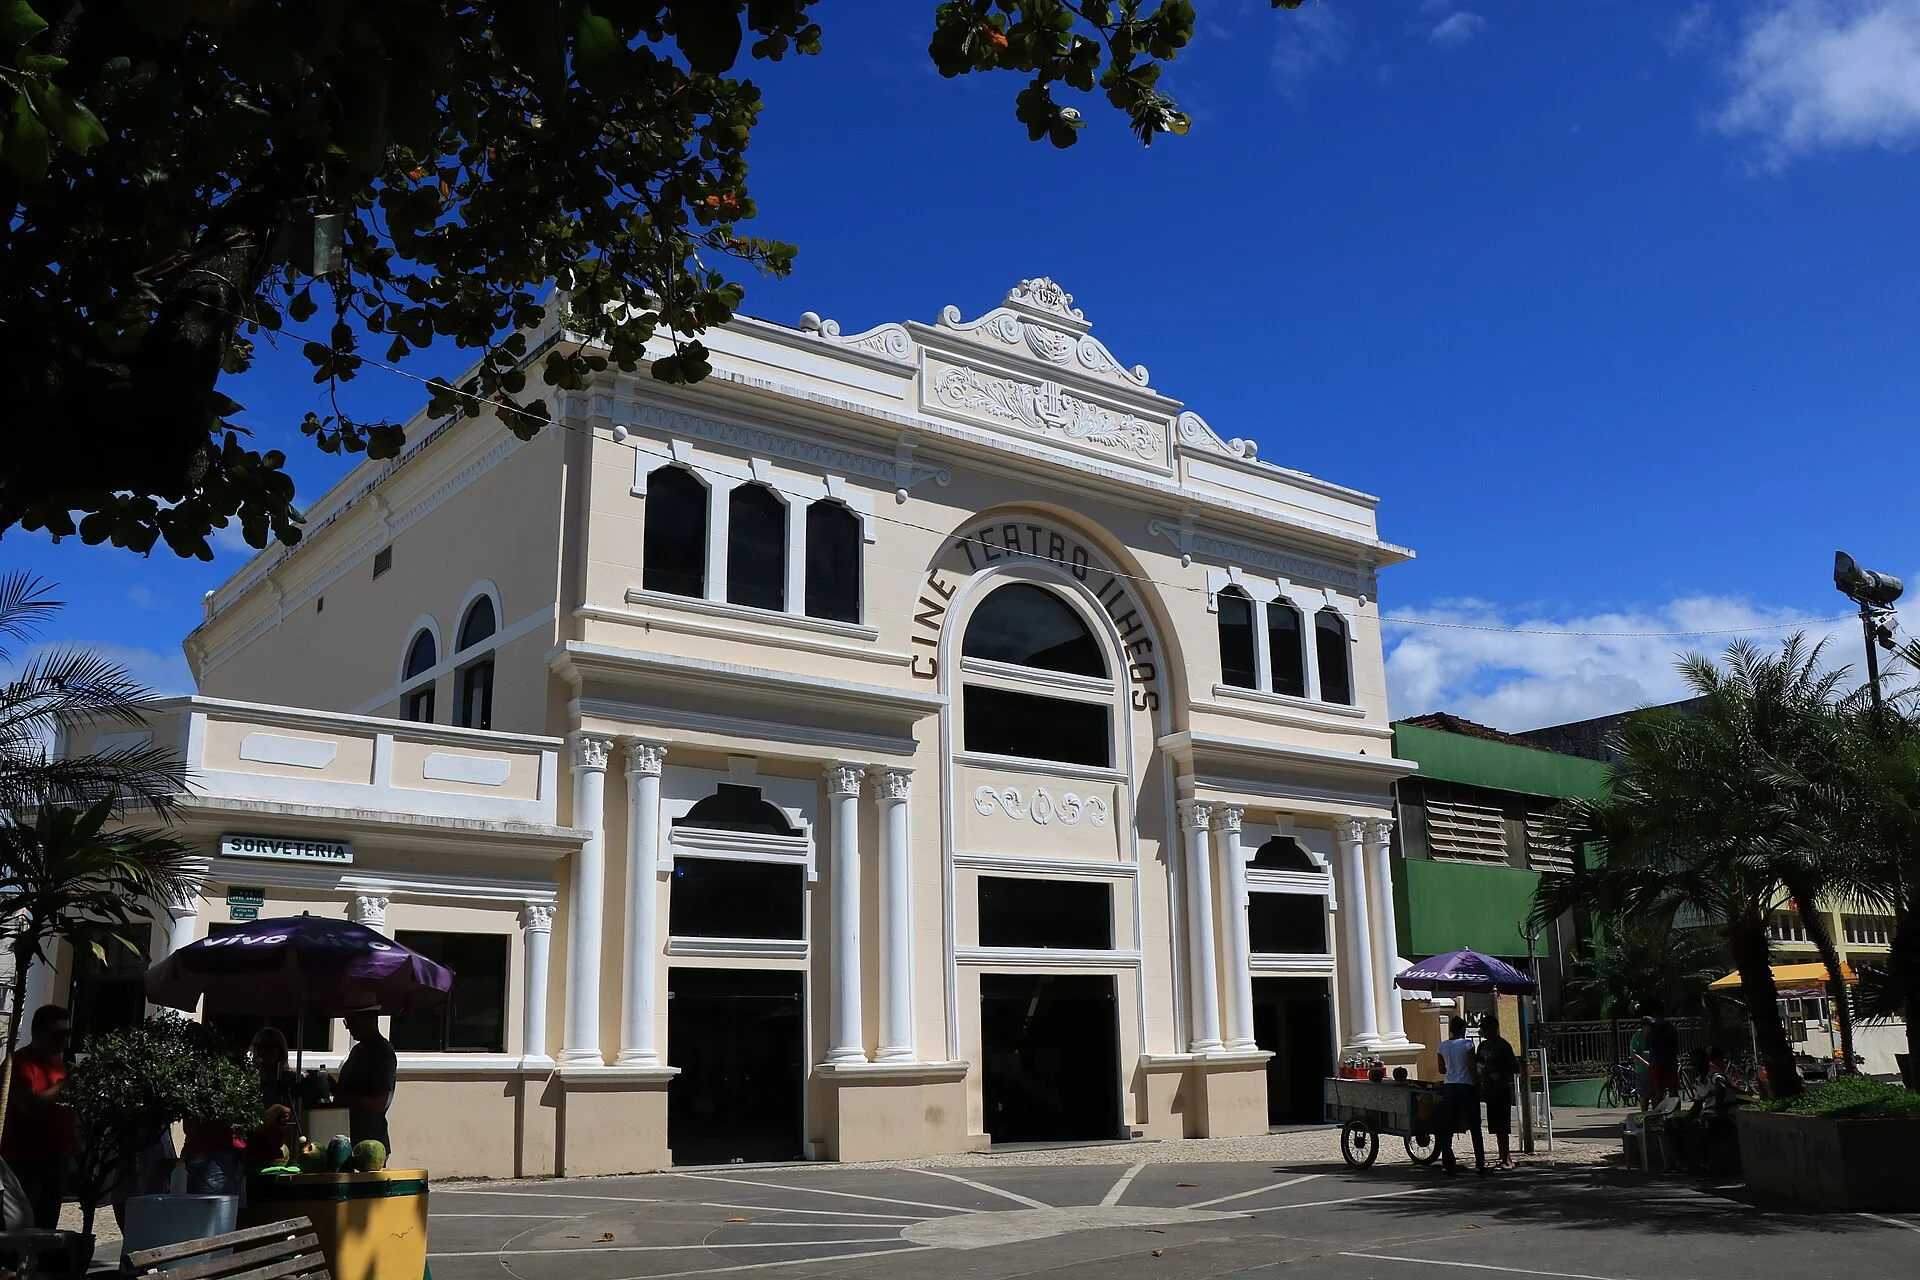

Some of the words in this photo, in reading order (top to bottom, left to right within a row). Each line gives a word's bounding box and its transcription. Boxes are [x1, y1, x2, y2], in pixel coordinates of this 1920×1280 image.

[911, 568, 957, 680] CINE
[955, 524, 1089, 581] TEATRO
[231, 838, 346, 859] SORVETERIA
[203, 934, 288, 947] vivo
[301, 933, 392, 950] vivo
[1405, 969, 1438, 978] vivo
